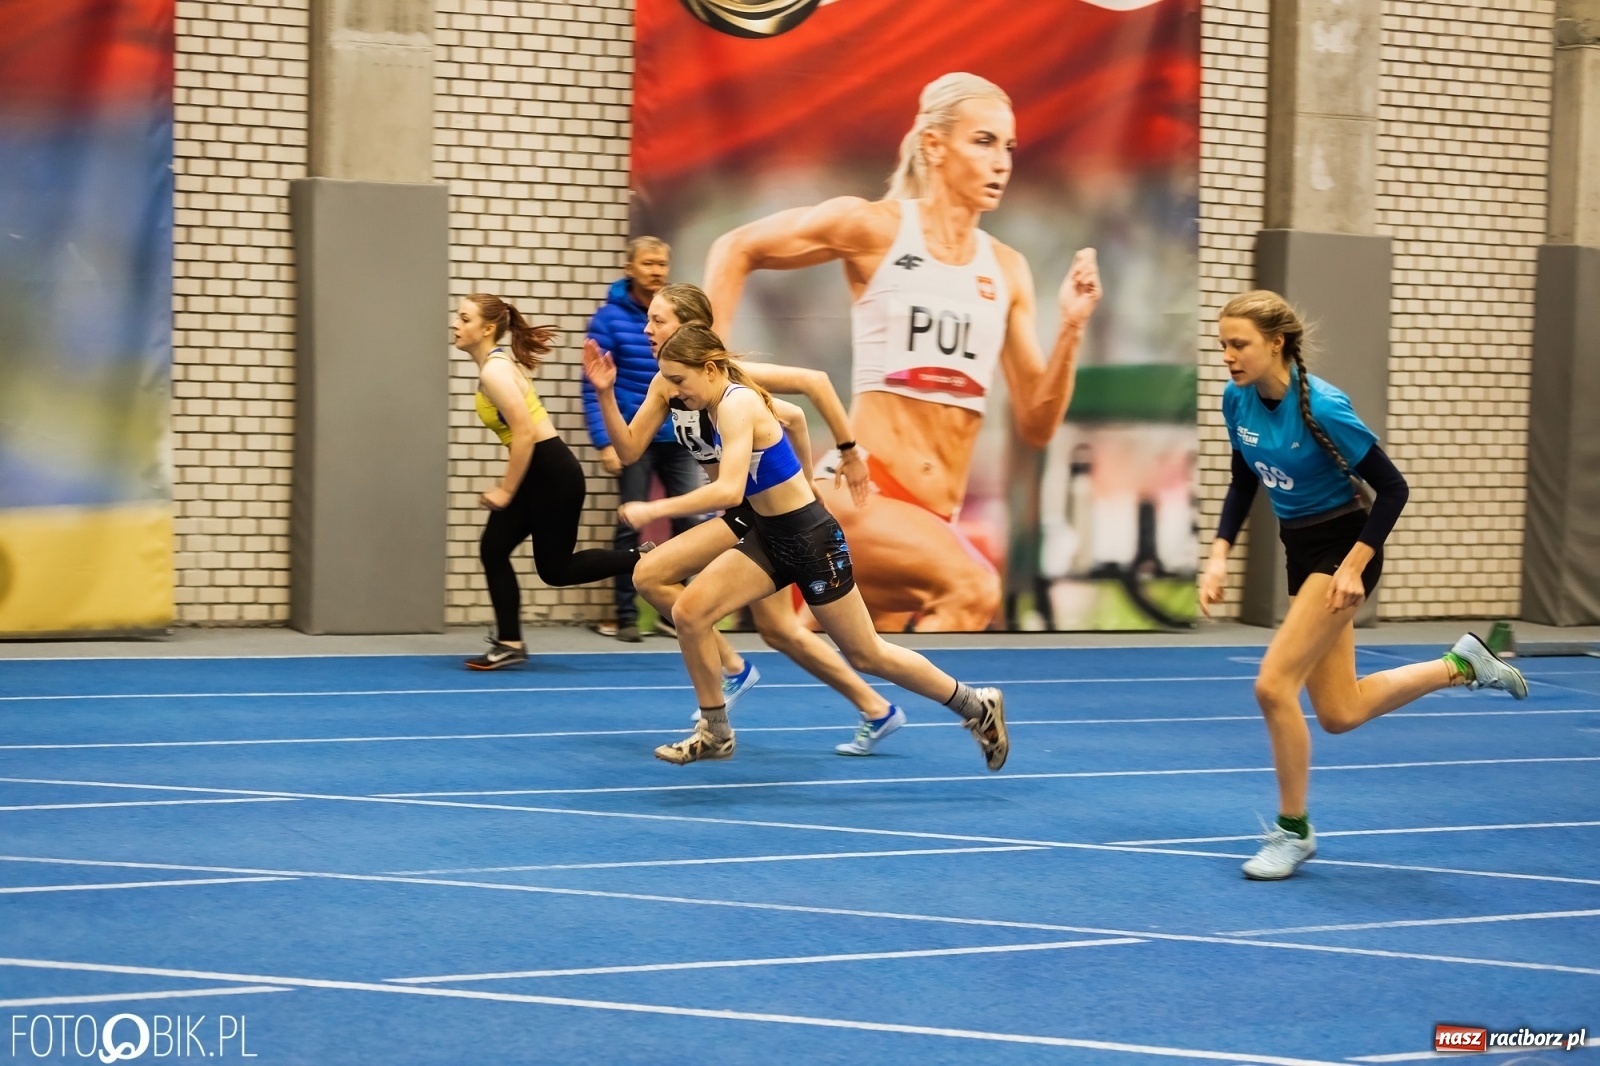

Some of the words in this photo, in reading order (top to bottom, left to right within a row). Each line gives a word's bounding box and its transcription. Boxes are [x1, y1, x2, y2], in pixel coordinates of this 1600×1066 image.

[907, 305, 976, 360] POL
[676, 424, 702, 453] 15
[1254, 461, 1294, 491] 69
